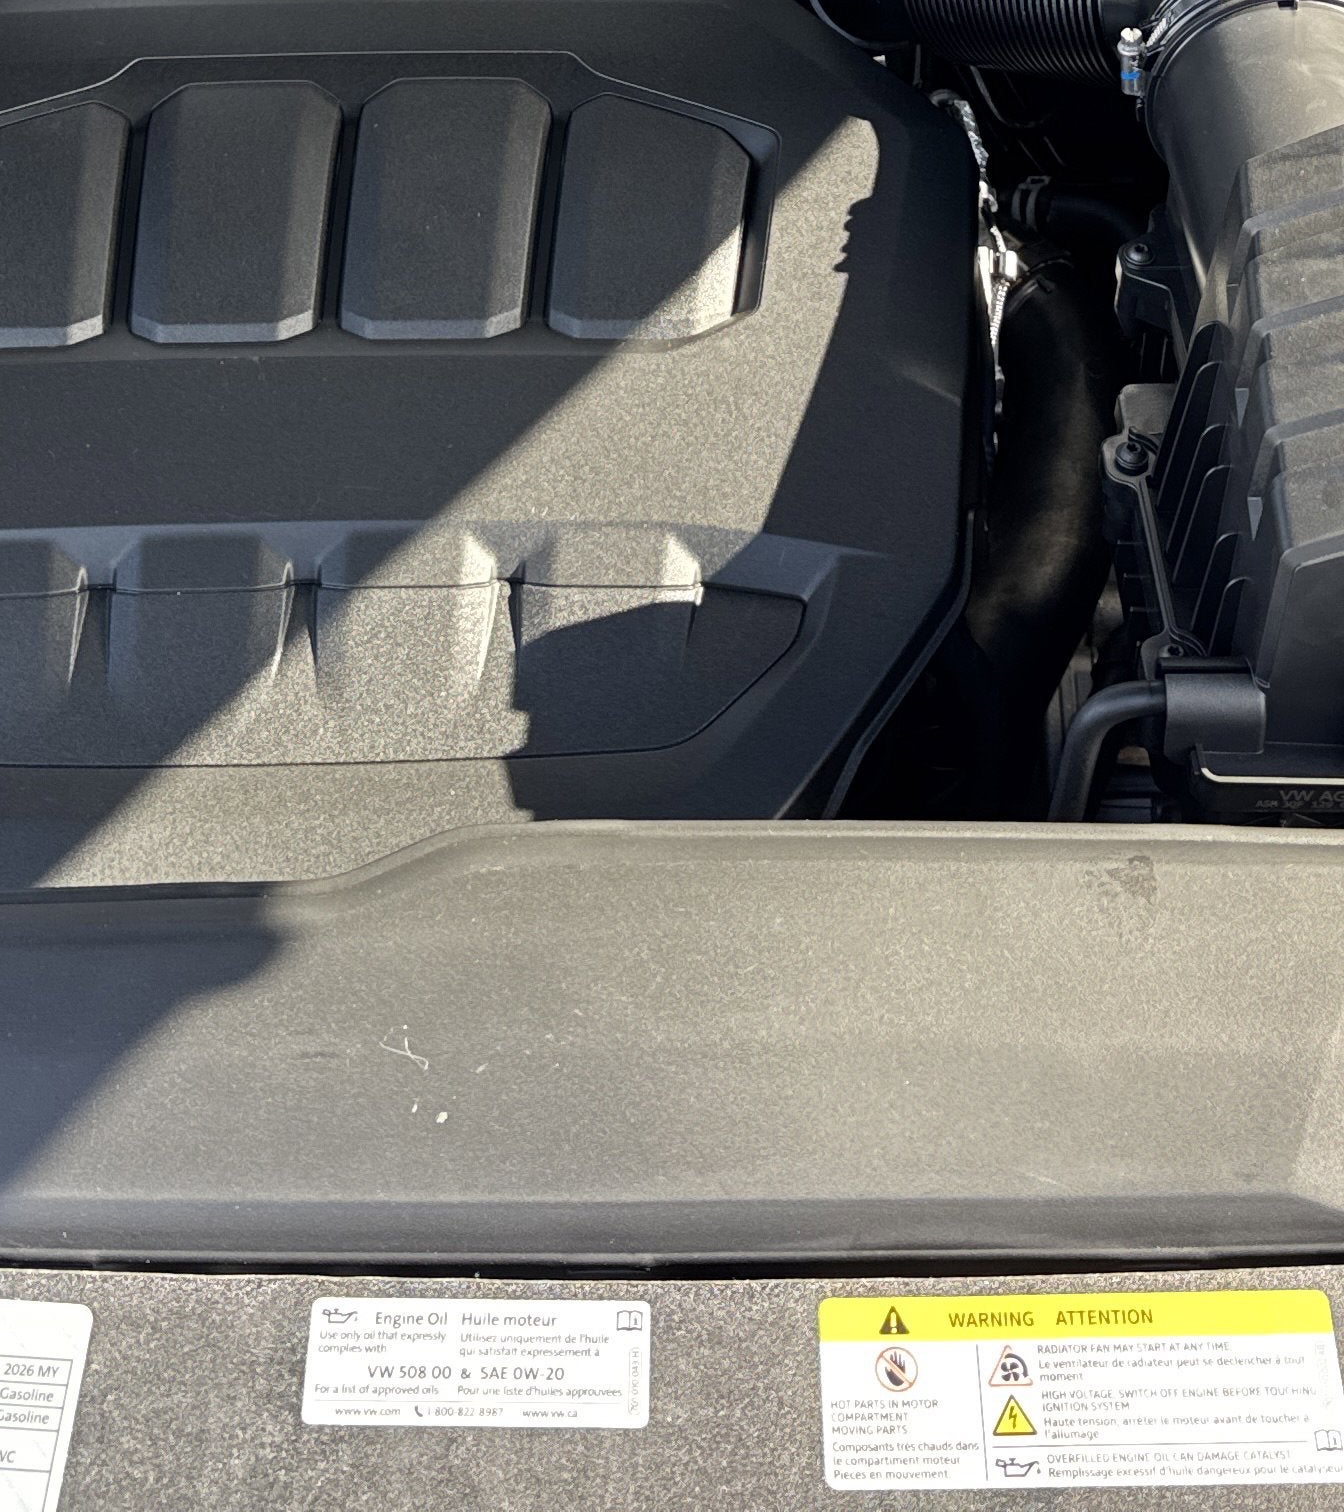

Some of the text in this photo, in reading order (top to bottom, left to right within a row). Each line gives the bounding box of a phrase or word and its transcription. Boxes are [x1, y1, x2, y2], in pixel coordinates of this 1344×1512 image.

[1280, 790, 1314, 801] VW
[375, 1311, 448, 1329] Engine Oil
[461, 1312, 558, 1326] Huile moteur
[948, 1308, 1153, 1328] WARNING ATTENTION
[319, 1330, 447, 1343] Use only oil that expressly
[460, 1333, 497, 1343] Utilisez
[500, 1334, 562, 1345] uniquement
[564, 1334, 577, 1344] de
[318, 1343, 387, 1355] complies with
[459, 1346, 518, 1357] qui satisfait
[1037, 1344, 1088, 1354] RADIATOR
[1090, 1344, 1110, 1353] FAN
[1113, 1343, 1134, 1353] MAY
[1136, 1343, 1166, 1352] START
[1169, 1342, 1180, 1351] AT
[1183, 1342, 1203, 1351] ANY
[1039, 1359, 1050, 1369] Le
[1053, 1358, 1108, 1369] ventilateur
[1112, 1358, 1124, 1368] de
[1177, 1358, 1200, 1369] peut
[4, 1363, 60, 1378] 2026 MY
[367, 1365, 565, 1381] VW 508 00 & SAE 0W-20
[1040, 1373, 1083, 1382] moment
[0, 1387, 54, 1402] Gasoline
[314, 1383, 439, 1397] For a list of approved oils
[457, 1385, 480, 1395] Pour
[482, 1388, 501, 1396] une
[503, 1385, 524, 1396] liste
[1041, 1386, 1317, 1400] HIGH SWITCH OFF ENGINE BEFORE TOUCHING
[830, 1399, 939, 1410] HOT PARTS IN MOTOR
[1042, 1401, 1130, 1412] IGNITION SYSTEM
[831, 1412, 909, 1422] COMPARTMENT
[1043, 1417, 1075, 1427] Haute
[1160, 1416, 1169, 1424] le
[1173, 1415, 1209, 1425] moteur
[1213, 1415, 1242, 1424] avant
[1245, 1414, 1257, 1424] de
[1261, 1414, 1300, 1424] toucher
[832, 1425, 908, 1436] MOVING PARTS
[832, 1441, 894, 1455] Composants
[917, 1441, 954, 1452] chauds
[955, 1441, 980, 1451] dans
[833, 1455, 961, 1468] le compartiment moteur
[1047, 1451, 1291, 1463] OVERFILLED ENGINE OIL CAN DAMAGE CATALYST
[869, 1470, 883, 1479] en
[1048, 1466, 1114, 1479] Remplissage
[1116, 1466, 1156, 1477] excessif
[1197, 1466, 1251, 1477] dangereux
[1254, 1466, 1277, 1476] pour
[1280, 1464, 1289, 1474] le
